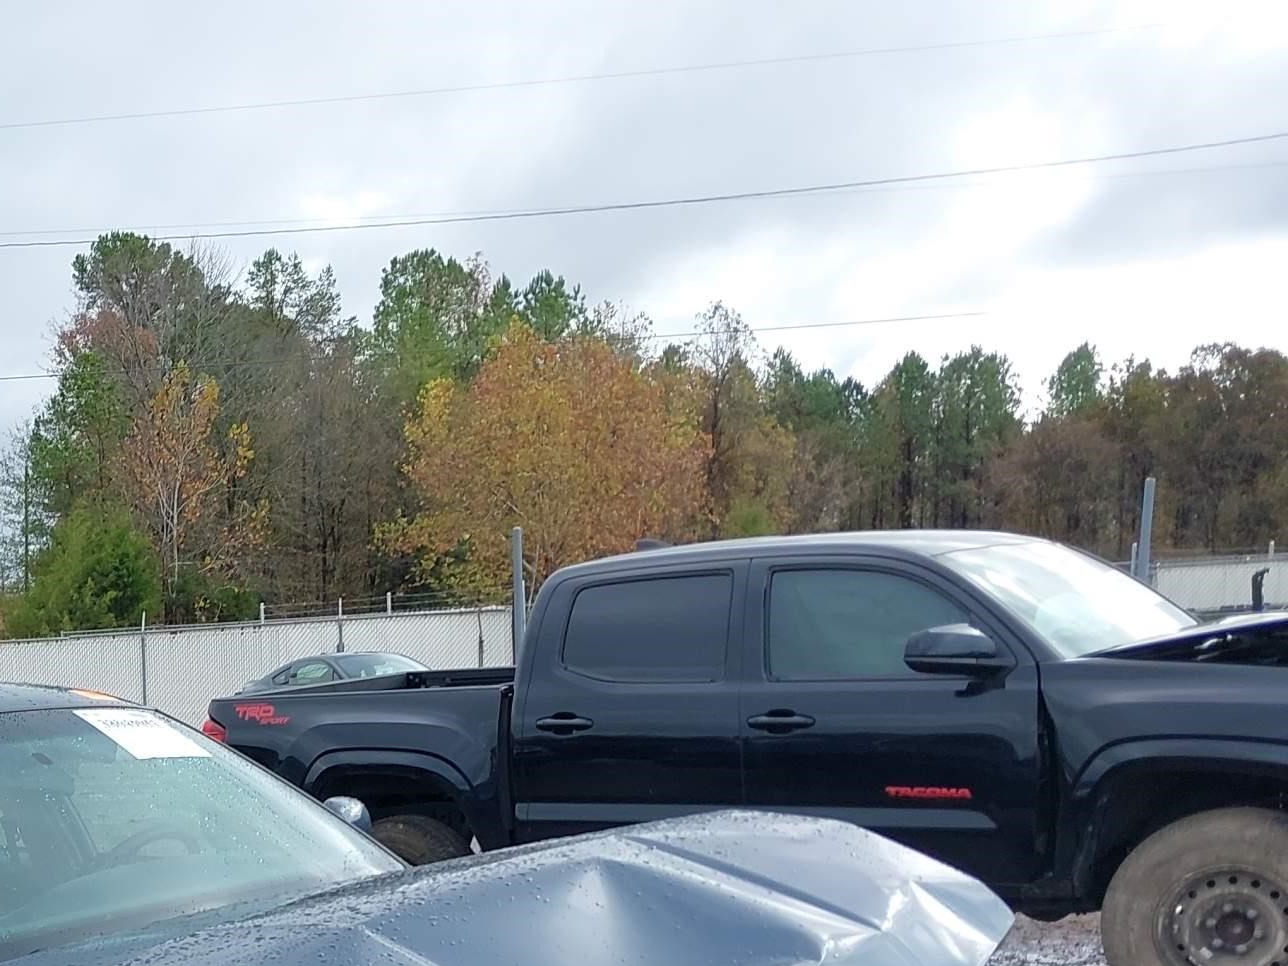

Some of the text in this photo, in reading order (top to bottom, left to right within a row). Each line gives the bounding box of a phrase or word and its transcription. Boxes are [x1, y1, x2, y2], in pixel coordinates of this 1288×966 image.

[234, 702, 275, 721] TRD
[259, 715, 291, 726] SPORT
[885, 785, 973, 799] TACOMA
